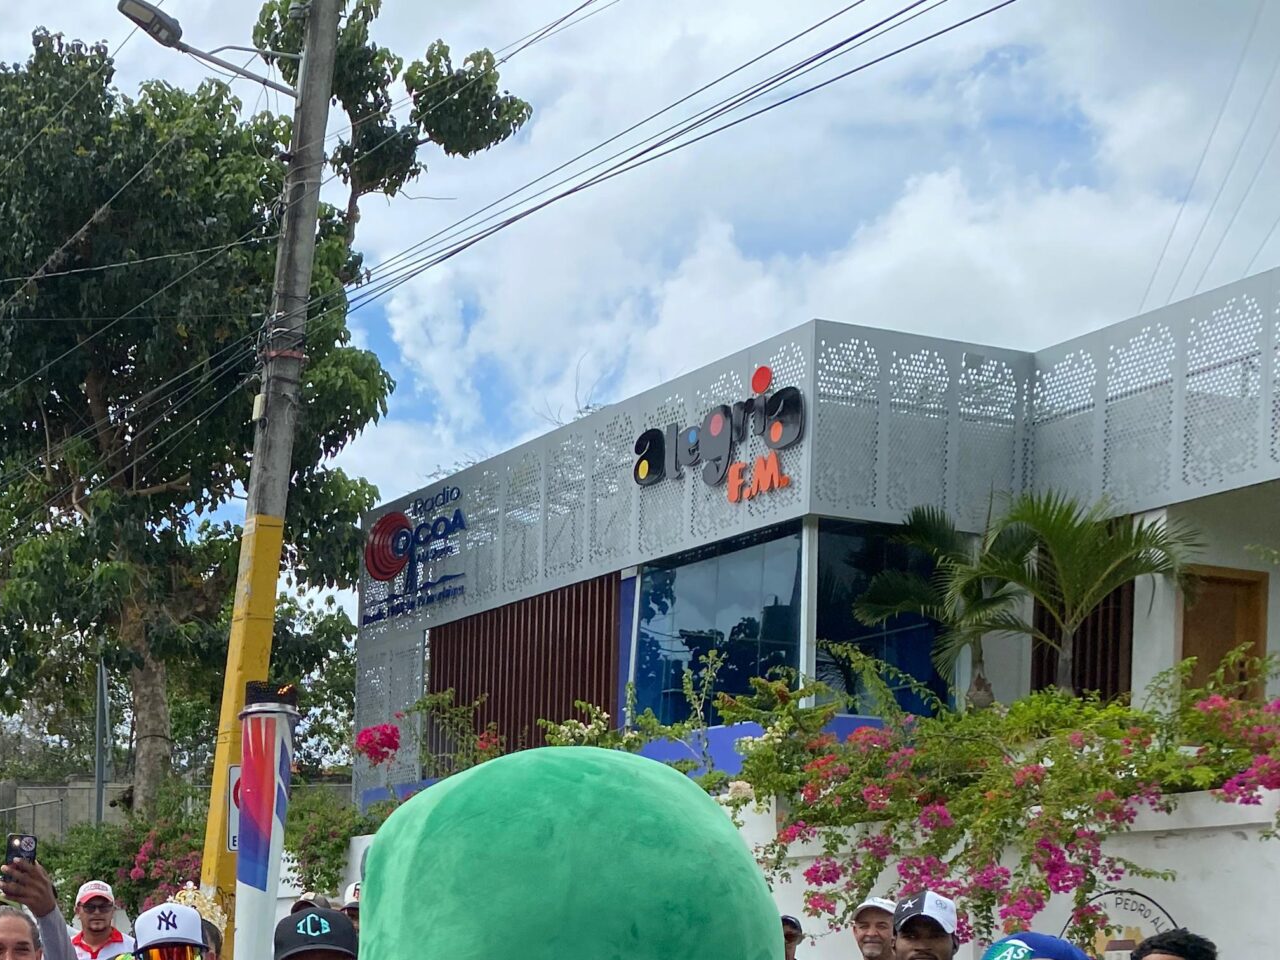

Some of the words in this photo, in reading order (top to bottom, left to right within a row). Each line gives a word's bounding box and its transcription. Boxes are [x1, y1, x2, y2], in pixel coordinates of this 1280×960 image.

[634, 366, 805, 487] alegria
[727, 451, 790, 504] F.M.
[413, 485, 461, 516] Radio
[157, 910, 178, 931] NY
[1115, 896, 1152, 919] PEDRO
